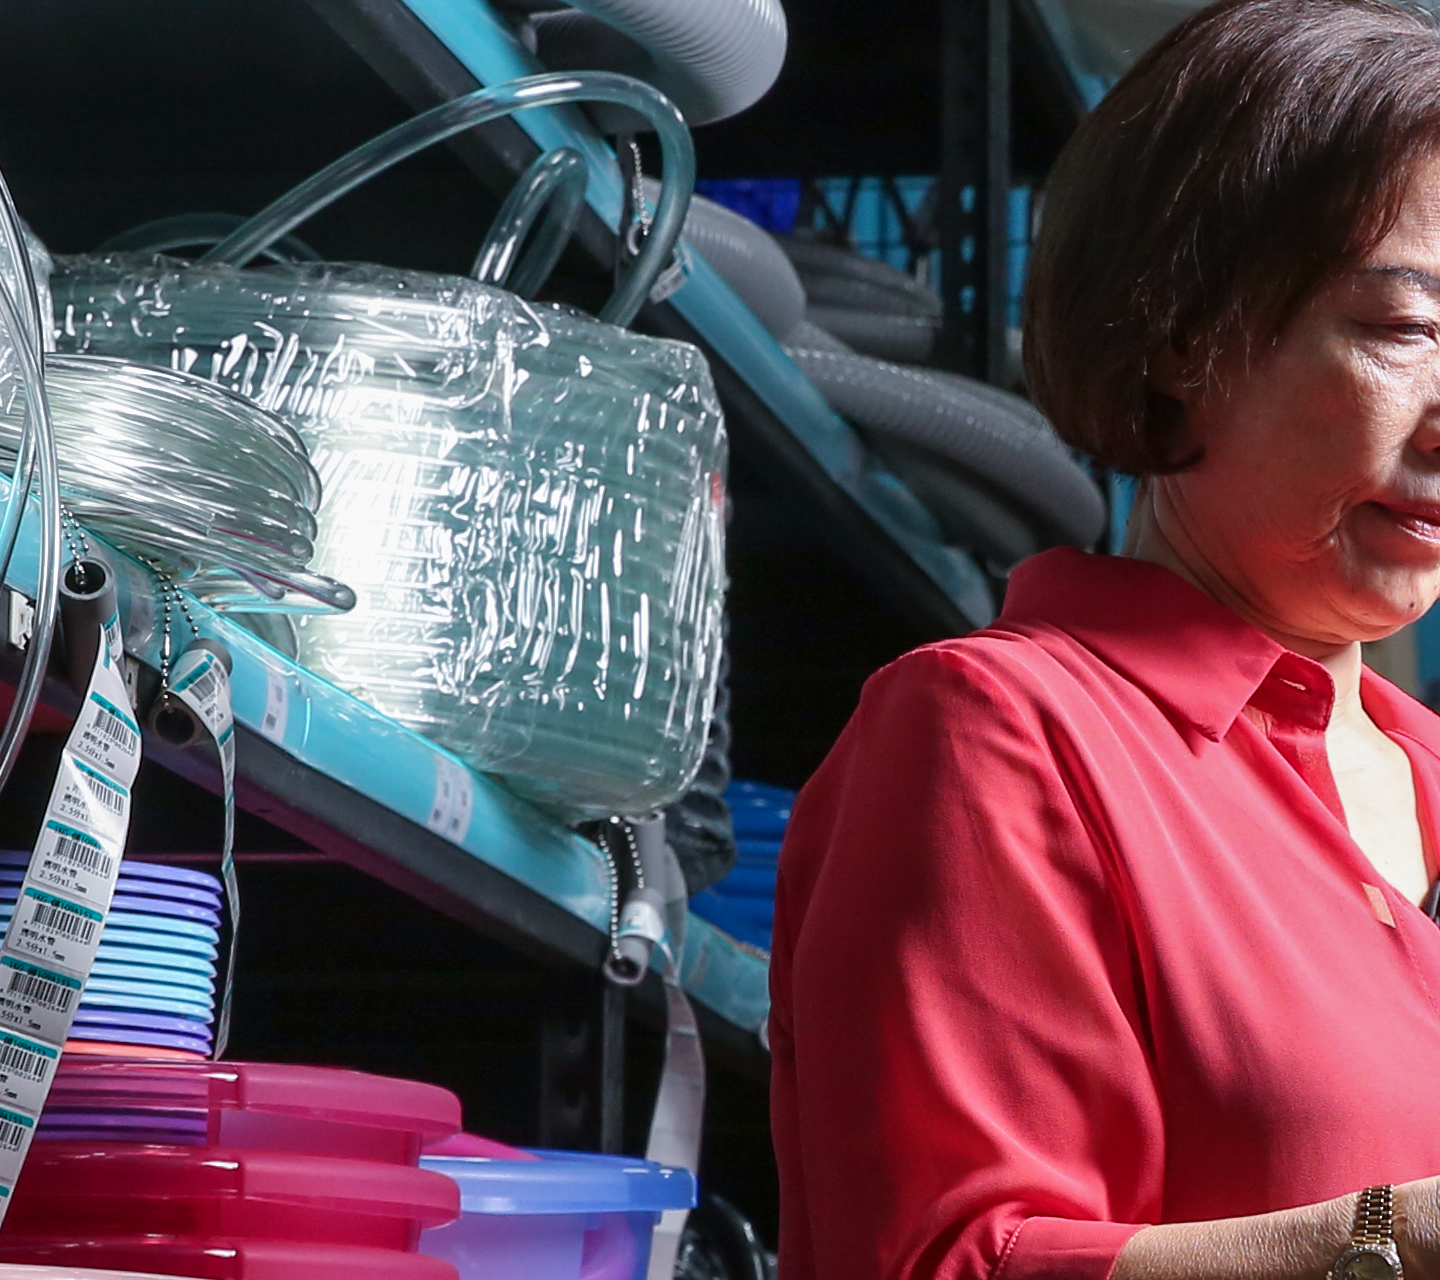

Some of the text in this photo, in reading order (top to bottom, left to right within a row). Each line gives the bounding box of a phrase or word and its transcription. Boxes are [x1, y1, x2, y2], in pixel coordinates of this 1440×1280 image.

[42, 860, 78, 879] 透明水管
[20, 927, 56, 945] 透明水管
